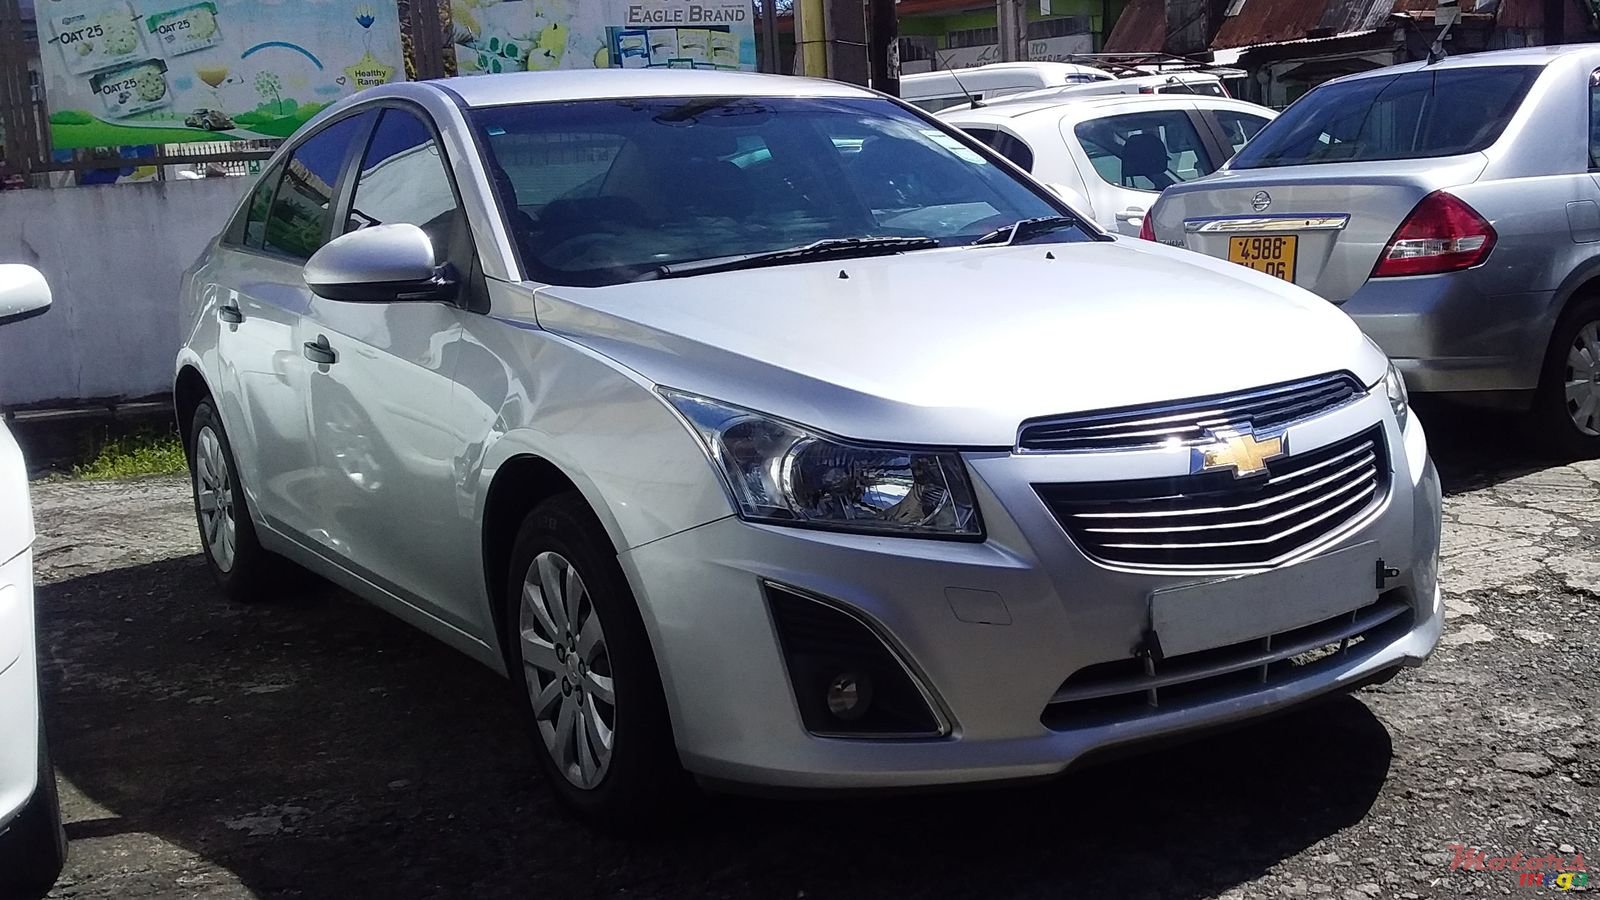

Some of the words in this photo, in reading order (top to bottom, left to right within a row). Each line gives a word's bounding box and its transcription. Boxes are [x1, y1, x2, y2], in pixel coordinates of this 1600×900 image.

[629, 6, 683, 23] EAGLE
[689, 5, 746, 22] BRAND
[60, 30, 84, 45] OAT
[86, 24, 104, 39] 25
[158, 23, 177, 35] OAT
[178, 19, 191, 30] 25
[355, 69, 386, 78] Healthy
[102, 83, 121, 95] OAT
[122, 78, 138, 90] 25
[1241, 237, 1283, 260] 4988
